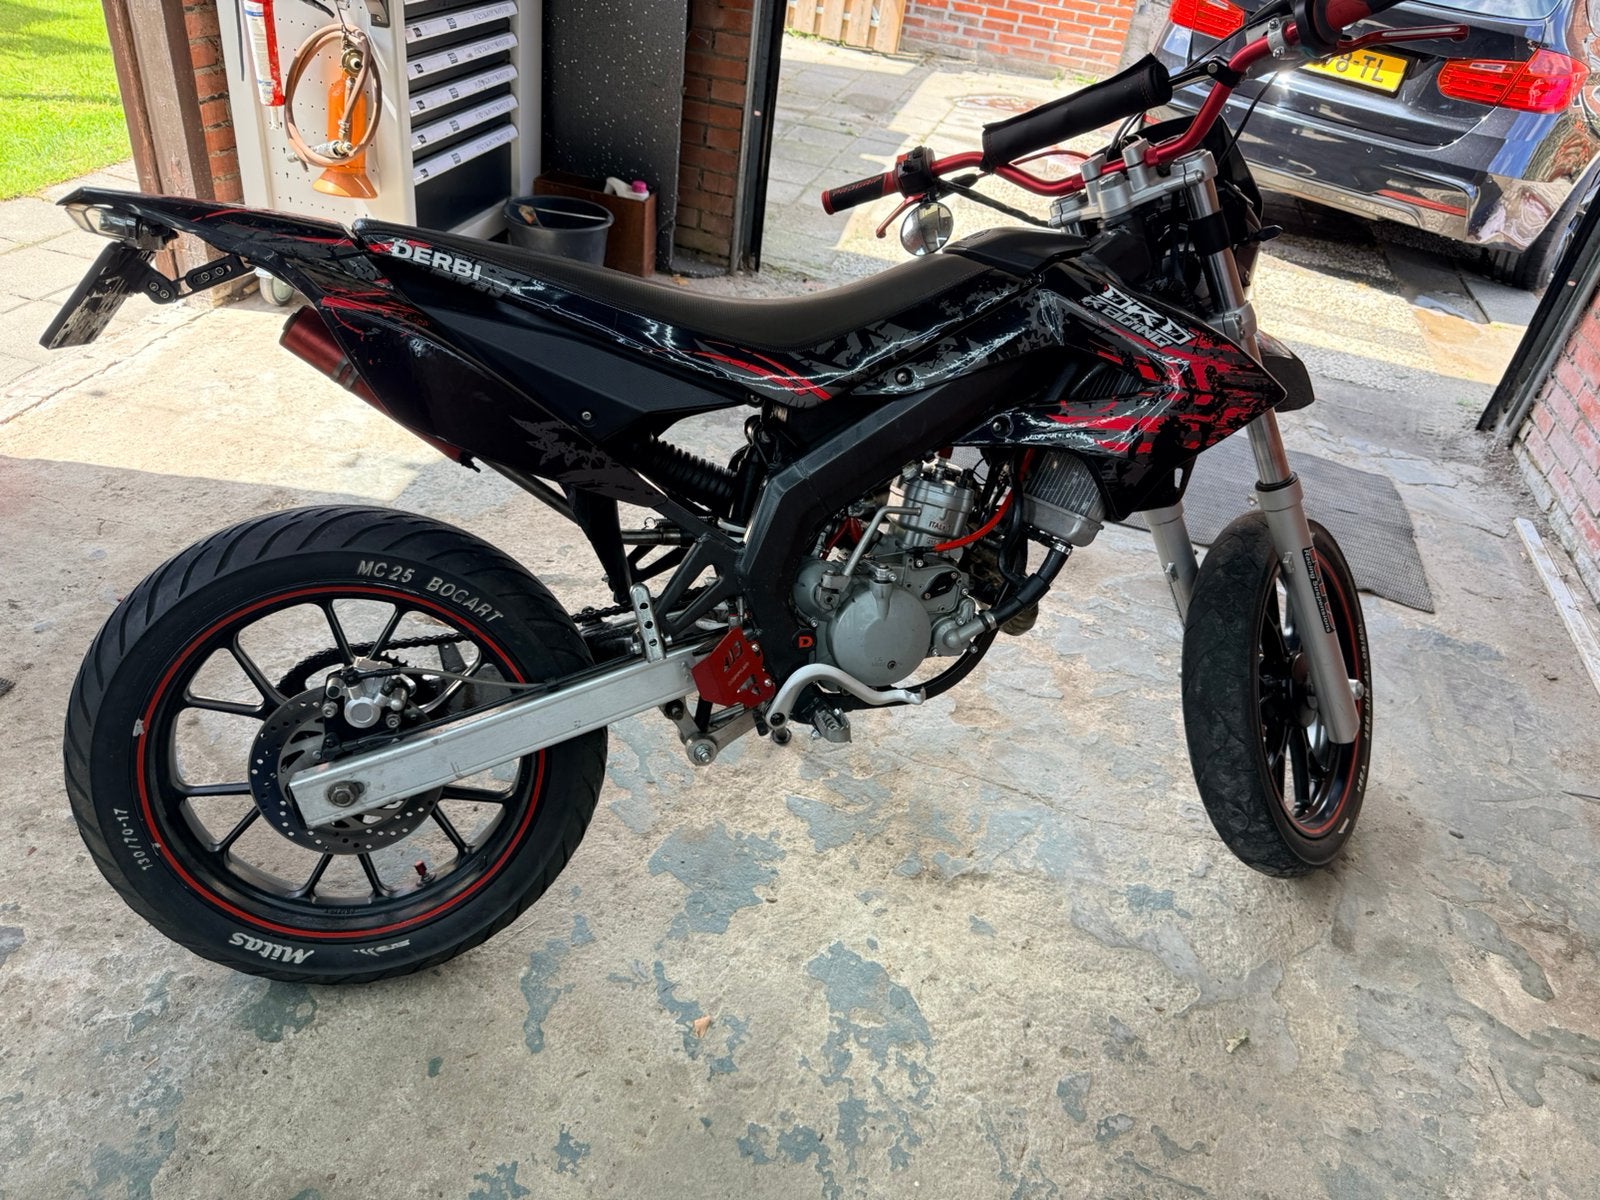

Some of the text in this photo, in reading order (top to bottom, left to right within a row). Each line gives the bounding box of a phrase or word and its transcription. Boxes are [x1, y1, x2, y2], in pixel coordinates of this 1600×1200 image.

[391, 239, 482, 281] DERBI
[425, 576, 505, 623] BOGART
[1303, 549, 1332, 633] Racing Suspensions
[113, 808, 153, 871] 130/70-17
[228, 932, 315, 965] Mitas
